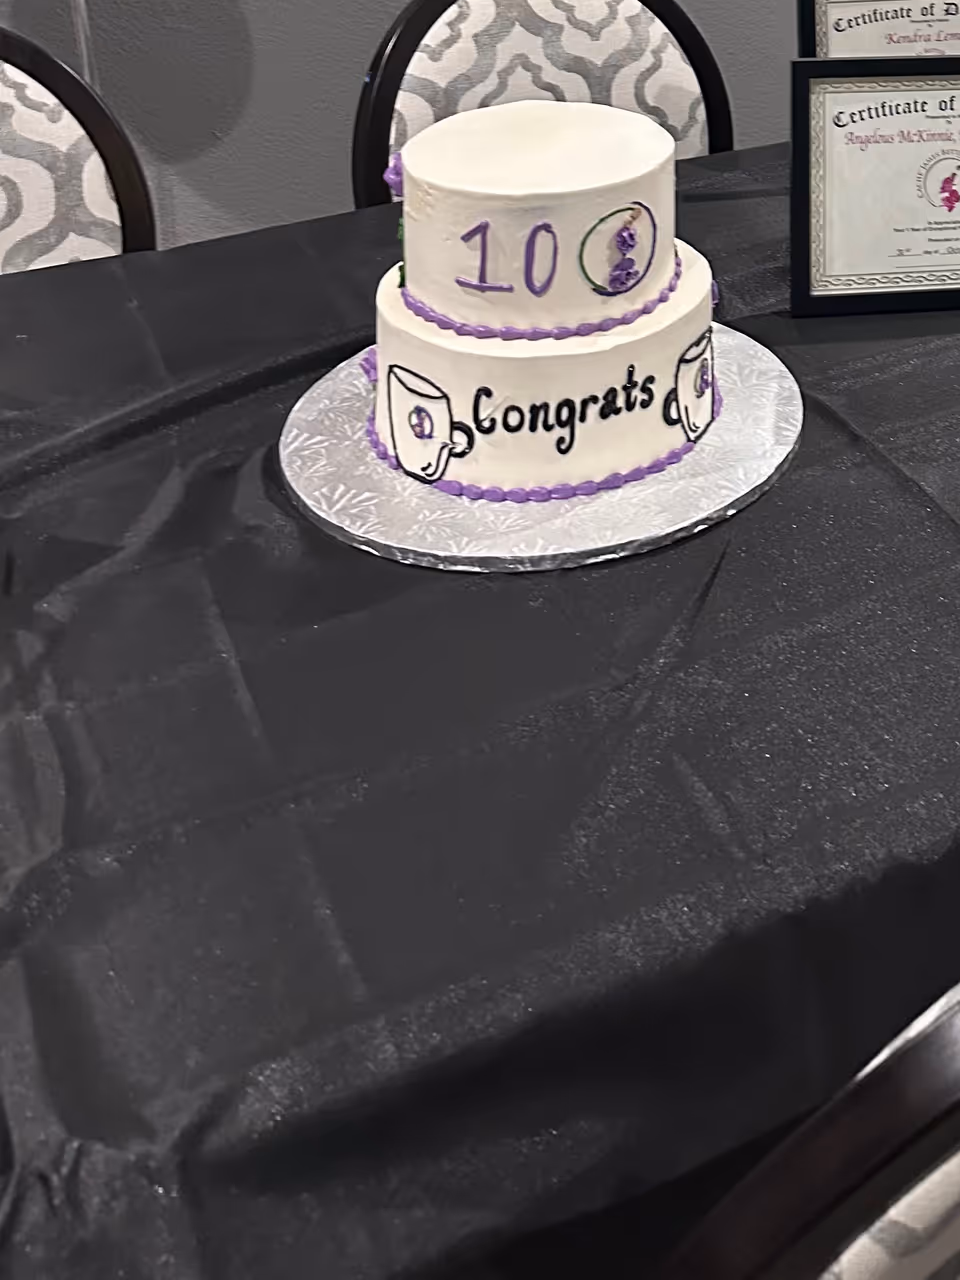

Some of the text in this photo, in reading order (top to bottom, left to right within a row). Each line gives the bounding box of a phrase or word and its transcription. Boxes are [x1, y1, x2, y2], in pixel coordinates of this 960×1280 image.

[833, 6, 913, 32] Certificate
[920, 3, 935, 17] of
[886, 29, 932, 45] Kendra
[832, 97, 928, 128] Certificate
[938, 95, 955, 112] of
[455, 220, 558, 297] 10
[473, 364, 656, 455] Congrats
